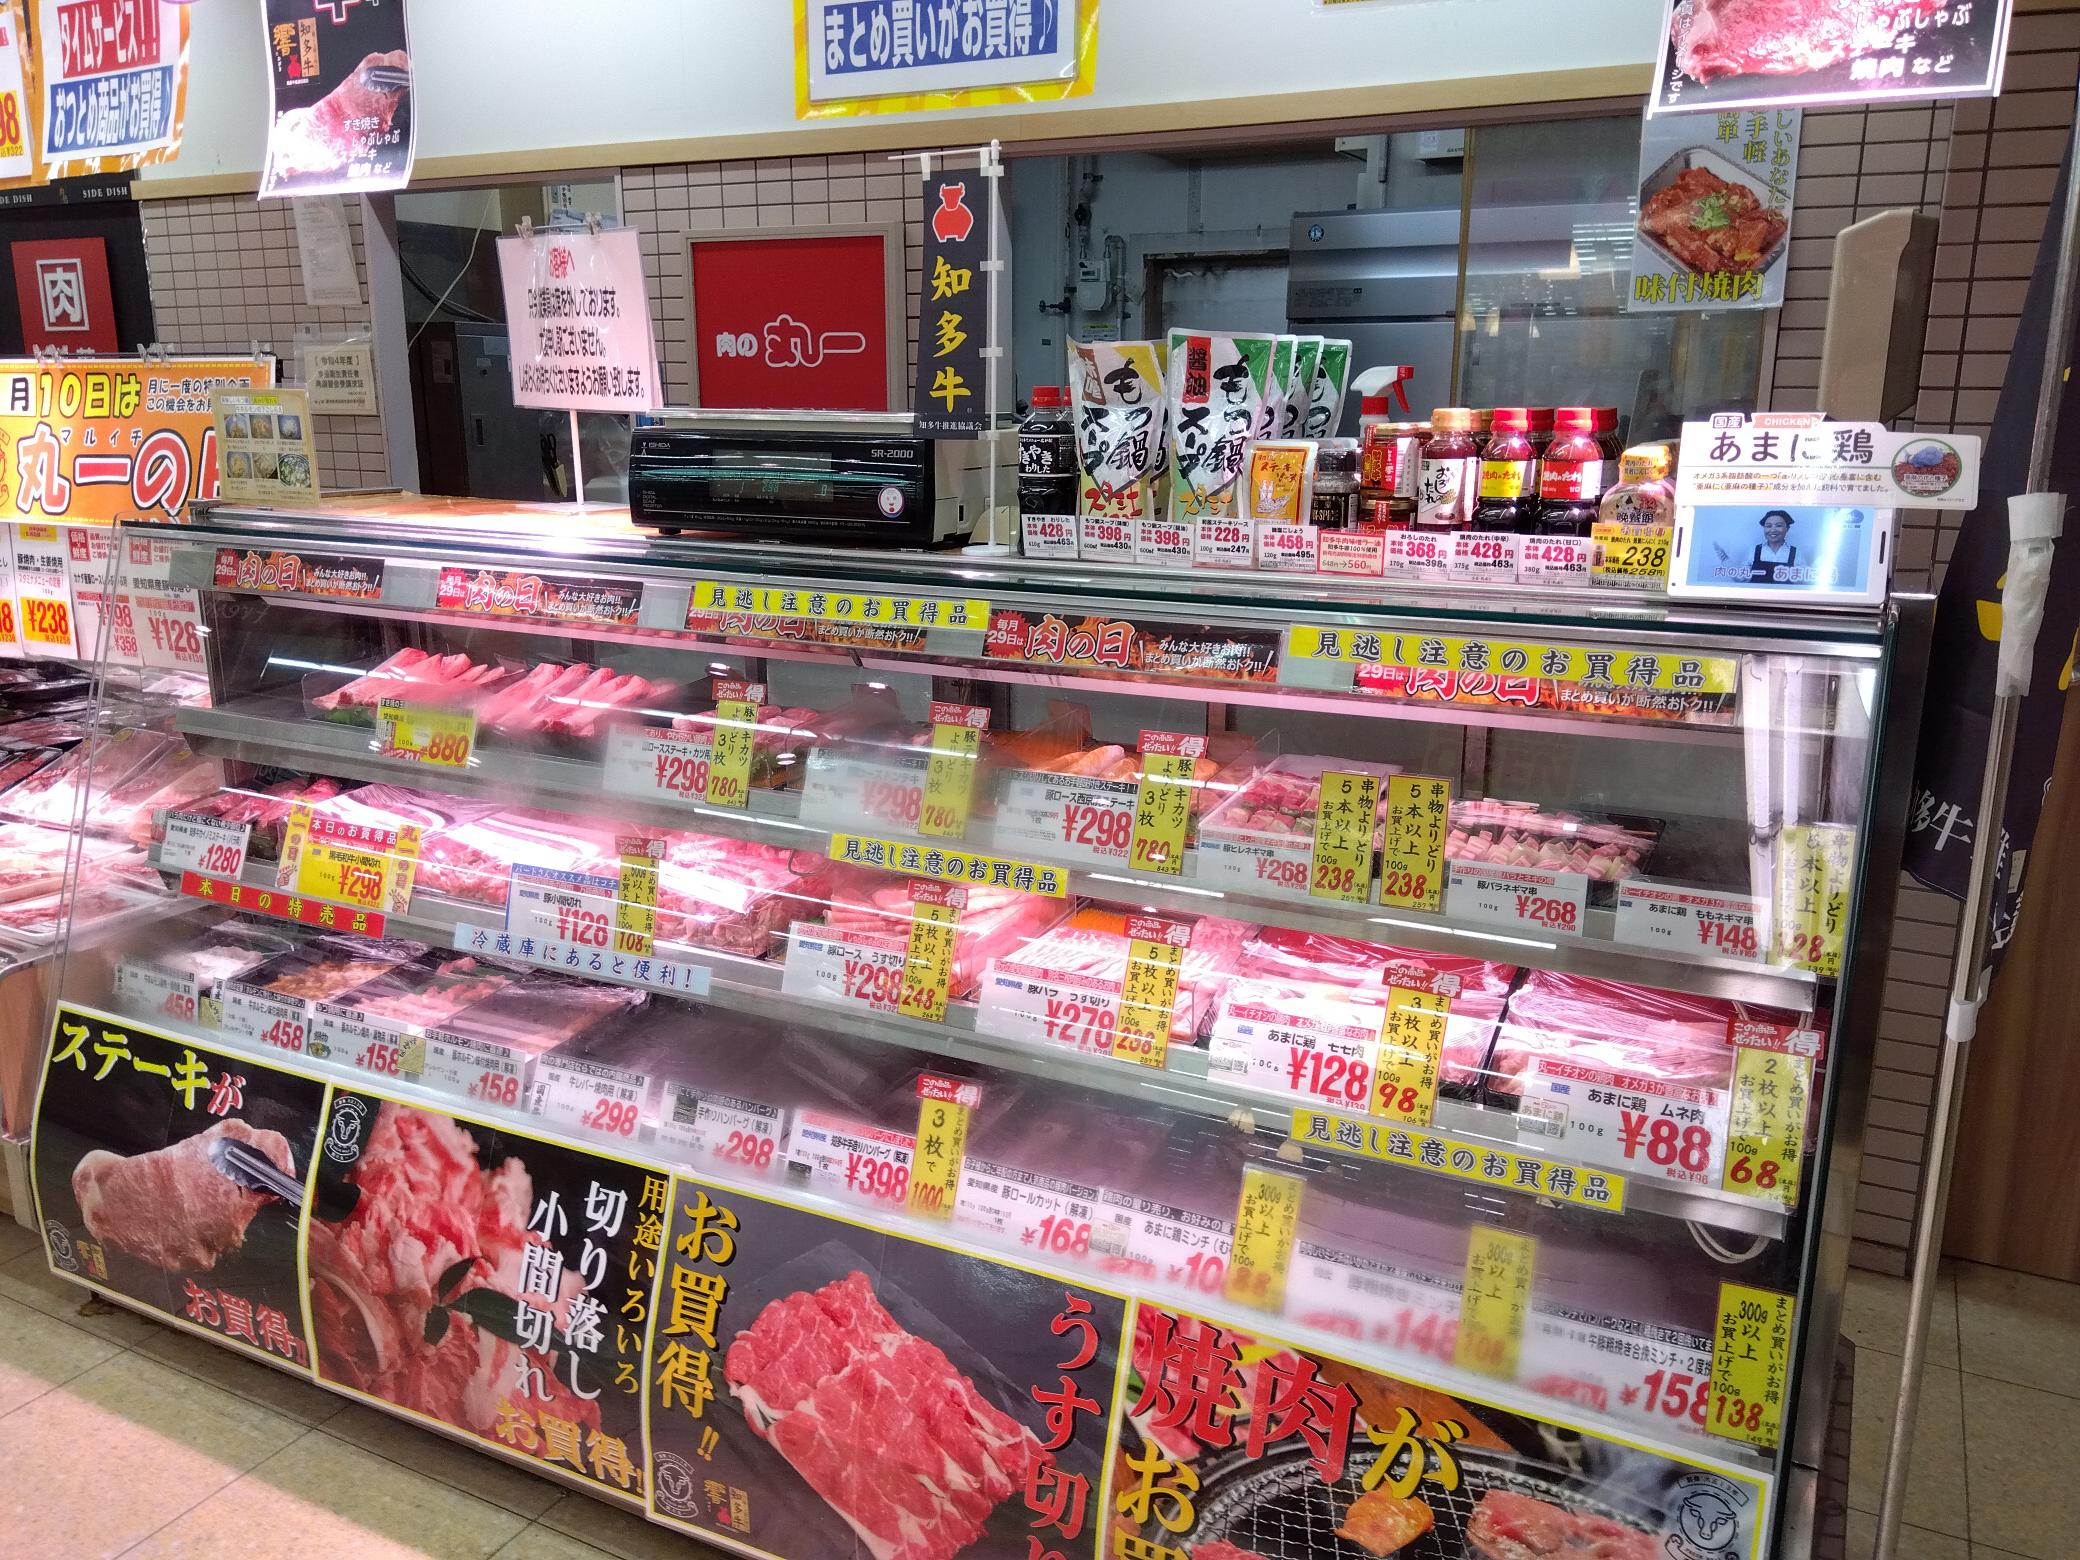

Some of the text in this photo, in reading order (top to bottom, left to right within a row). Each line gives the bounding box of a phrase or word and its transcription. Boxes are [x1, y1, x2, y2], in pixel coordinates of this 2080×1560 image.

[1856, 3, 1973, 31] しゃぶしゃぶ
[273, 23, 297, 57] 響
[300, 23, 314, 76] 知多牛
[1827, 33, 1916, 60] ステーキ
[1850, 54, 1955, 80] 焼肉 など
[343, 117, 380, 132] すき焼き
[352, 129, 401, 147] しゃぶしゃぶ
[373, 162, 393, 174] など
[1766, 106, 1795, 222] しいあなたに
[13, 194, 33, 203] DISH
[82, 186, 128, 199] SIDE DISH
[44, 265, 85, 326] 肉
[1634, 270, 1766, 306] 味付焼肉
[929, 255, 972, 414] 知多牛
[1186, 346, 1208, 398] 醤油
[919, 419, 983, 432] 知多牛推進協議会
[1103, 357, 1153, 473] もつ鍋
[1202, 354, 1252, 475] もつ鍋
[1712, 414, 1812, 428] 国産 CHICKEN
[59, 428, 143, 447] マルイチ
[871, 449, 914, 459] SR-2000
[1080, 404, 1111, 478] スープ
[1176, 405, 1211, 480] スープ
[1709, 428, 1874, 465] あまに鶏
[1401, 533, 1437, 543] おろしのたれ
[1405, 541, 1447, 559] 368円
[1471, 541, 1514, 559] 428円
[1529, 537, 1582, 547] 焼肉のたれ(甘口)
[1541, 545, 1587, 563] 428円
[236, 550, 301, 591] 肉の日
[1622, 546, 1666, 568] 238
[465, 570, 543, 615] 肉の日
[708, 587, 968, 626] 見逃し注意のお買得品
[26, 599, 69, 635] ¥238
[114, 634, 137, 653] ¥358
[148, 616, 200, 654] ¥128
[1024, 613, 1136, 669] 肉の日
[1158, 639, 1251, 658] みんな大好きお肉!!
[1144, 653, 1262, 673] まとめ買いが断然おトク!!
[1313, 630, 1706, 689] 見逃し注意のお買得品
[1559, 688, 1715, 713] まとめ買いが断然おトク!!
[1177, 735, 1206, 757] 得
[655, 754, 709, 794] ¥298
[711, 776, 738, 798] 780
[925, 804, 955, 829] 780
[1045, 789, 1135, 810] 豚ロース西京テーキ
[1138, 791, 1156, 829] 3枚
[1332, 780, 1353, 851] 5本以上
[311, 818, 397, 845] 本日のお買得品
[1061, 803, 1133, 849] ¥298
[1355, 779, 1374, 867] 串物よりどり
[1389, 805, 1404, 856] お買上げで
[1402, 783, 1423, 856] 5本以上
[1426, 783, 1445, 873] 串物よりどり
[198, 843, 242, 875] ¥1280
[841, 838, 1058, 893] 見逃し注意のお買得品
[1093, 846, 1128, 858] 税込¥322
[1135, 837, 1171, 864] 780
[1223, 843, 1275, 858] 豚ヒレネギマ串
[1255, 856, 1308, 884] ¥268
[1314, 864, 1355, 893] 238
[1385, 870, 1427, 900] 238
[1477, 880, 1538, 895] 豚バラネギマ串
[197, 878, 368, 932] 本日の特売品
[1514, 894, 1577, 925] ¥268
[1648, 902, 1754, 927] あまに鶏 ももネギマ串
[556, 906, 609, 948] ¥128
[618, 931, 643, 952] 108
[1163, 923, 1192, 948] 得
[1696, 919, 1758, 952] ¥148
[471, 929, 693, 988] 冷蔵庫にあると便利!
[827, 944, 906, 968] 豚ロース うす切り
[1777, 931, 1825, 963] 128
[842, 959, 903, 1005] ¥298
[901, 984, 936, 1010] 248
[1155, 946, 1179, 1032] まとめ買いがお得
[1429, 971, 1461, 998] 得
[260, 1018, 305, 1052] ¥458
[1267, 1029, 1317, 1050] あまに鶏
[1783, 1029, 1822, 1057] 得
[355, 1042, 400, 1076] ¥158
[1286, 1046, 1370, 1103] ¥128
[468, 1071, 519, 1107] ¥158
[1377, 1082, 1419, 1115] 98
[1587, 1088, 1706, 1125] あまに鶏 ムネ肉
[1755, 1057, 1778, 1140] 2枚以上
[580, 1097, 639, 1138] ¥298
[1569, 1120, 1605, 1137] 100g
[712, 1130, 775, 1170] ¥298
[923, 1108, 946, 1174] 3枚で
[1616, 1109, 1713, 1173] ¥88
[1730, 1140, 1759, 1156] 100g
[1304, 1115, 1612, 1203] 見逃し注意のお買得品
[1730, 1155, 1781, 1190] 68
[843, 1152, 910, 1204] ¥398
[966, 1177, 1095, 1221] 愛知県産 豚ロールカット(解凍)
[1019, 1213, 1092, 1258] ¥168
[511, 1189, 570, 1404] 小間切れ
[563, 1180, 629, 1402] 切り落し
[612, 1174, 668, 1395] 用途いろいろ
[1716, 1312, 1739, 1381] お買上げで
[1737, 1299, 1769, 1363] 300g以上
[1762, 1296, 1790, 1404] まとめ買いがお得
[1619, 1368, 1709, 1426] ¥158
[1714, 1395, 1763, 1433] 138
